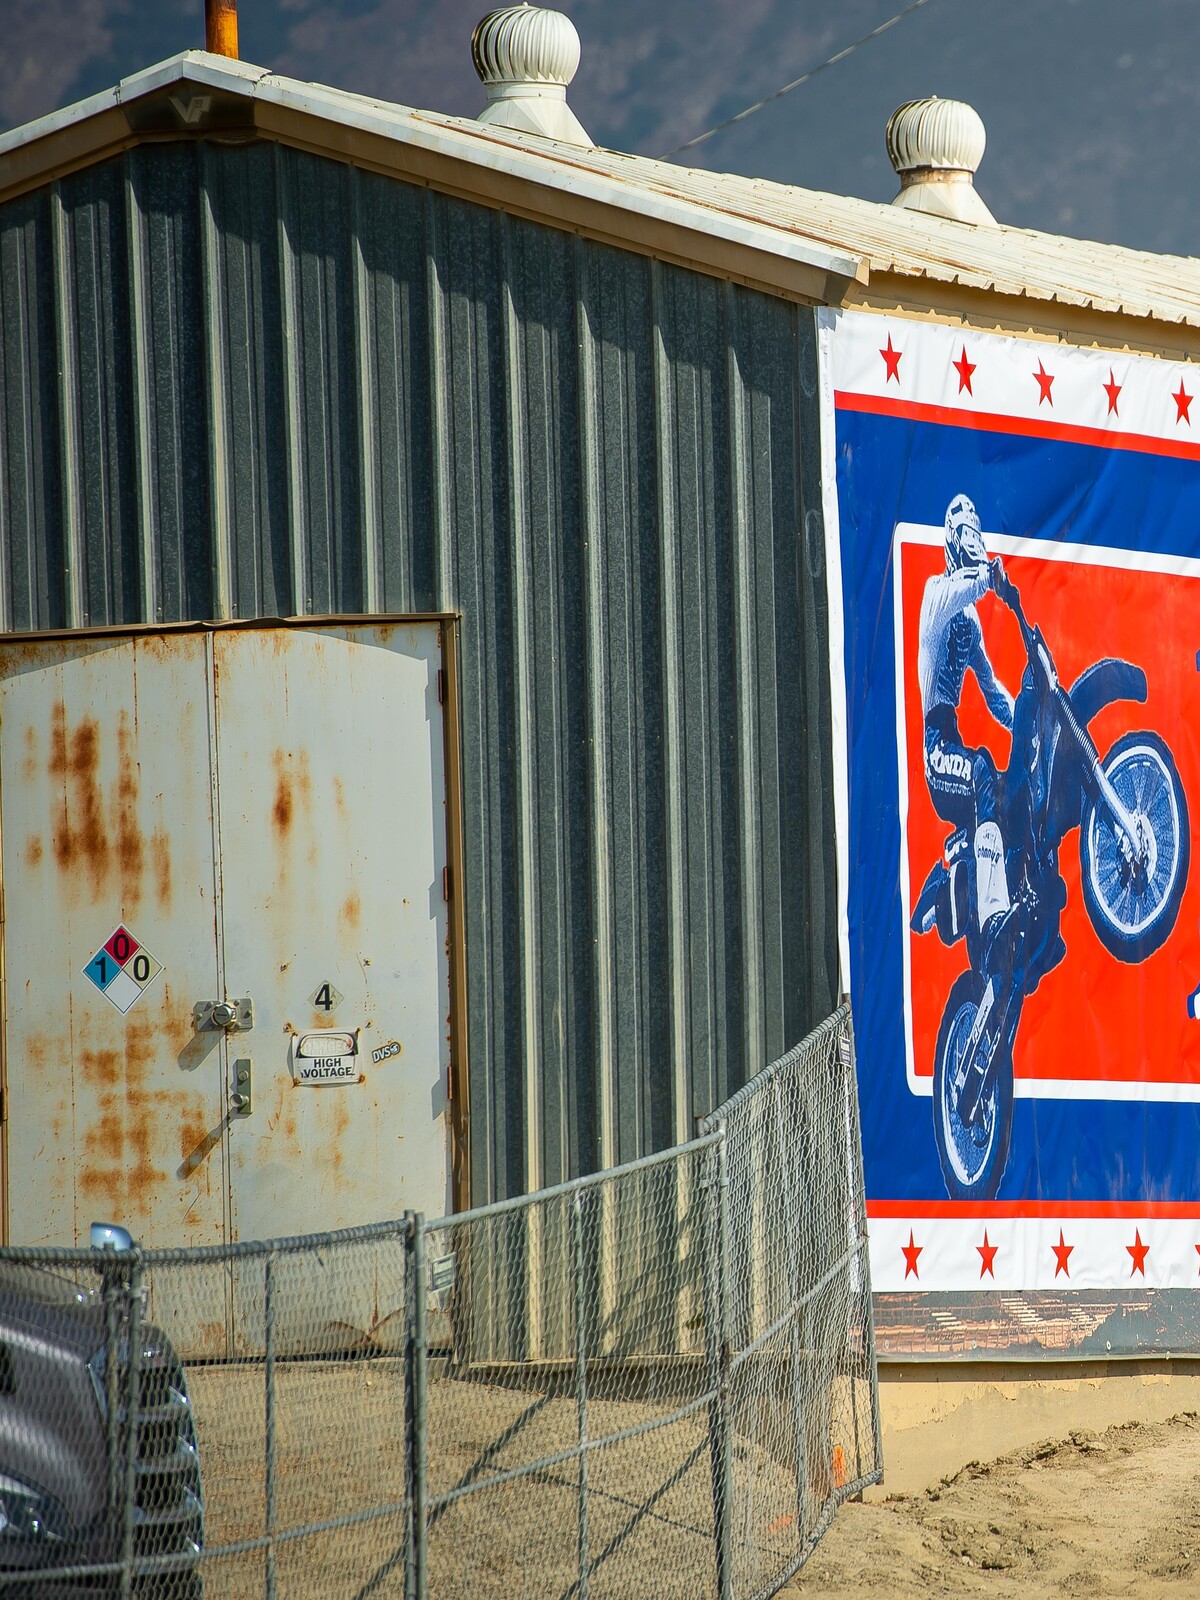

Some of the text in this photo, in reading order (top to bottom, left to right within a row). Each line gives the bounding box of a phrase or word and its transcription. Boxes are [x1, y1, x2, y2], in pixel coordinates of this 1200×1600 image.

[113, 934, 130, 960] 0
[95, 955, 150, 983] 1 0
[314, 983, 333, 1011] 4
[303, 1067, 353, 1079] VOLTAGE
[313, 1057, 342, 1068] HIGH
